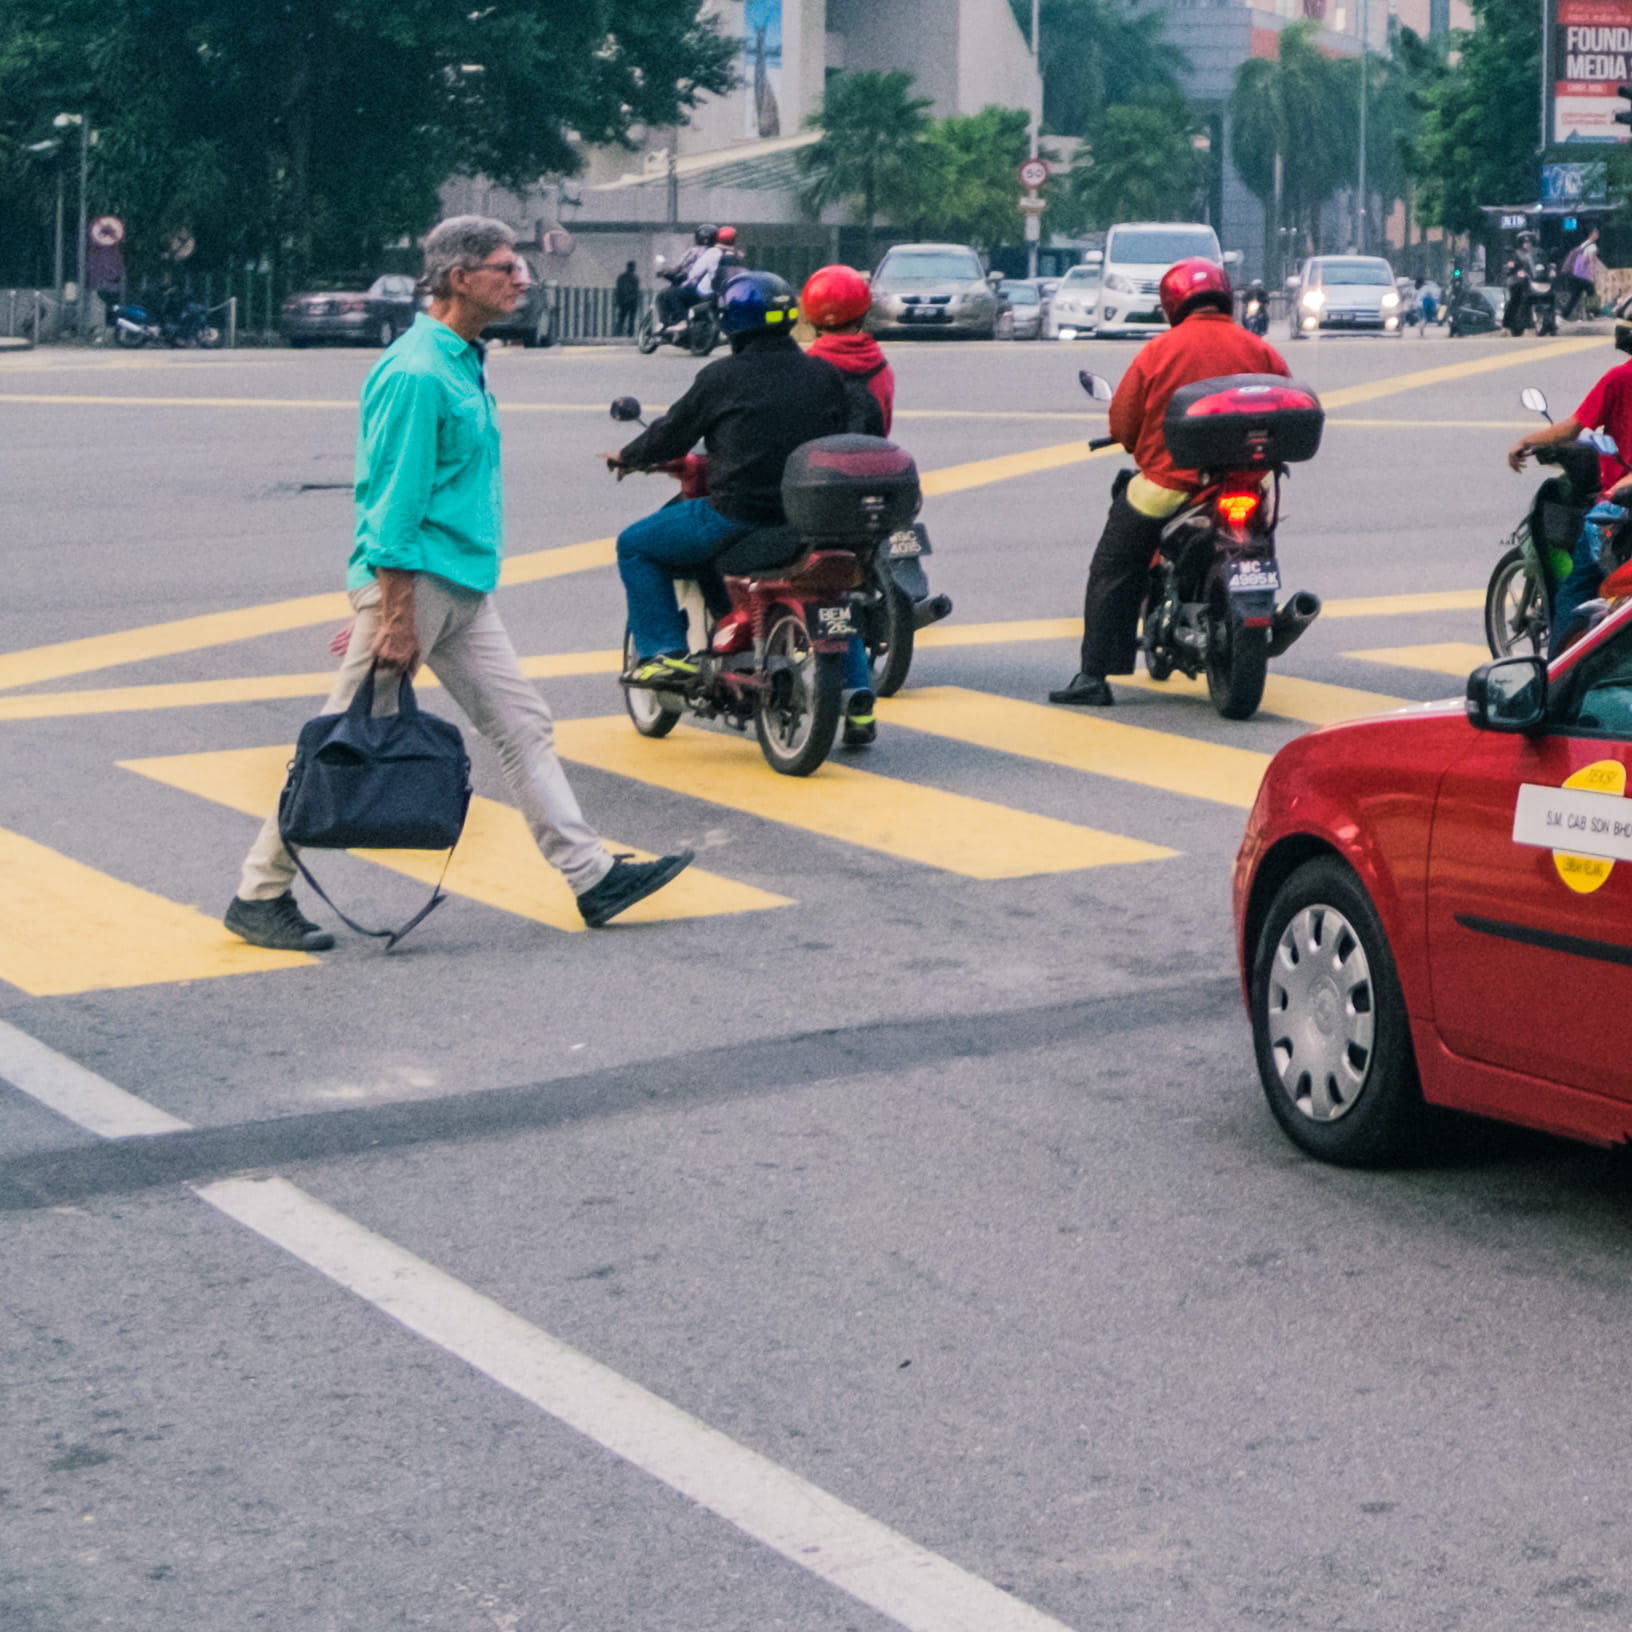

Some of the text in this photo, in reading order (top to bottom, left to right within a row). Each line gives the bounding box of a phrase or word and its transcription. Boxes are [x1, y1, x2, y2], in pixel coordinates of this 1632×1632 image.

[1566, 55, 1628, 80] MEDIA
[1567, 813, 1587, 831] CAB
[1591, 816, 1610, 834] SDN
[1613, 822, 1632, 839] BHD
